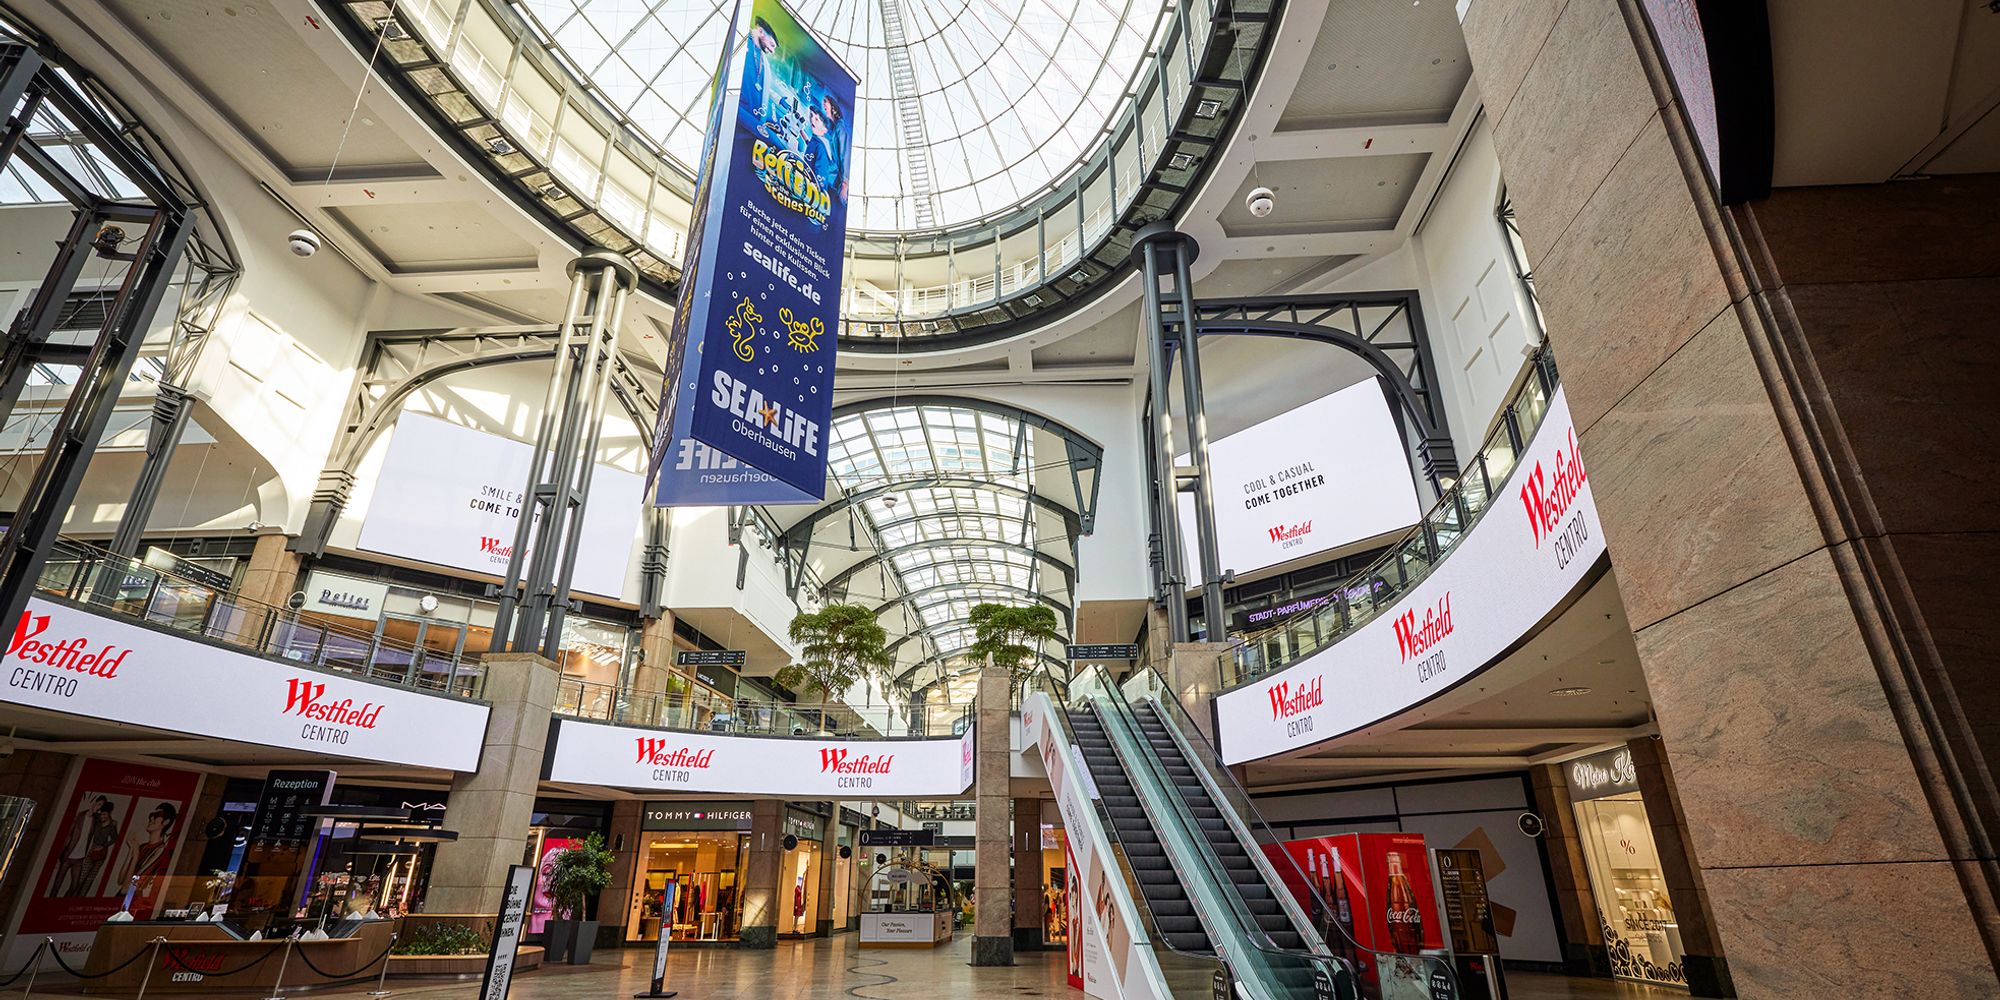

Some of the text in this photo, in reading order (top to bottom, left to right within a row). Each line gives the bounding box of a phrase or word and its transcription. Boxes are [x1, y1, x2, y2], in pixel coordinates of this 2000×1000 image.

[752, 139, 831, 216] Behind
[739, 205, 830, 279] für einen exklusiven Blick
[747, 200, 826, 265] Buche jetzt dein Ticket
[750, 225, 819, 281] hinter die Kulissen.
[743, 241, 821, 306] sealife.de
[711, 369, 764, 429] SEA
[732, 419, 796, 461] Oberhausen
[1243, 461, 1315, 495] COOL & CASUAL
[1245, 474, 1325, 510] COME TOGETHER
[469, 498, 502, 514] COME
[481, 485, 523, 504] SMILE &
[1268, 519, 1312, 543] Westfield
[1282, 537, 1304, 549] CENTRO
[1554, 510, 1588, 570] CENTRO
[489, 555, 510, 565] CENTR
[1391, 591, 1454, 664] Westfield
[1417, 650, 1446, 683] CENTRO
[9, 667, 78, 698] CENTRO
[1267, 674, 1324, 722] Westfield
[282, 678, 385, 729] Westfield
[301, 724, 350, 745] CENTRO
[1287, 715, 1313, 738] CENTRO
[635, 737, 716, 769] Westfield
[818, 747, 895, 774] Westfield
[273, 778, 318, 790] Rezeption
[652, 768, 690, 783] CENTRO
[838, 777, 872, 788] CENTRO
[647, 811, 751, 820] TOMMY HILFIGER
[1624, 918, 1650, 931] SINCE
[171, 972, 204, 982] CENTRO
